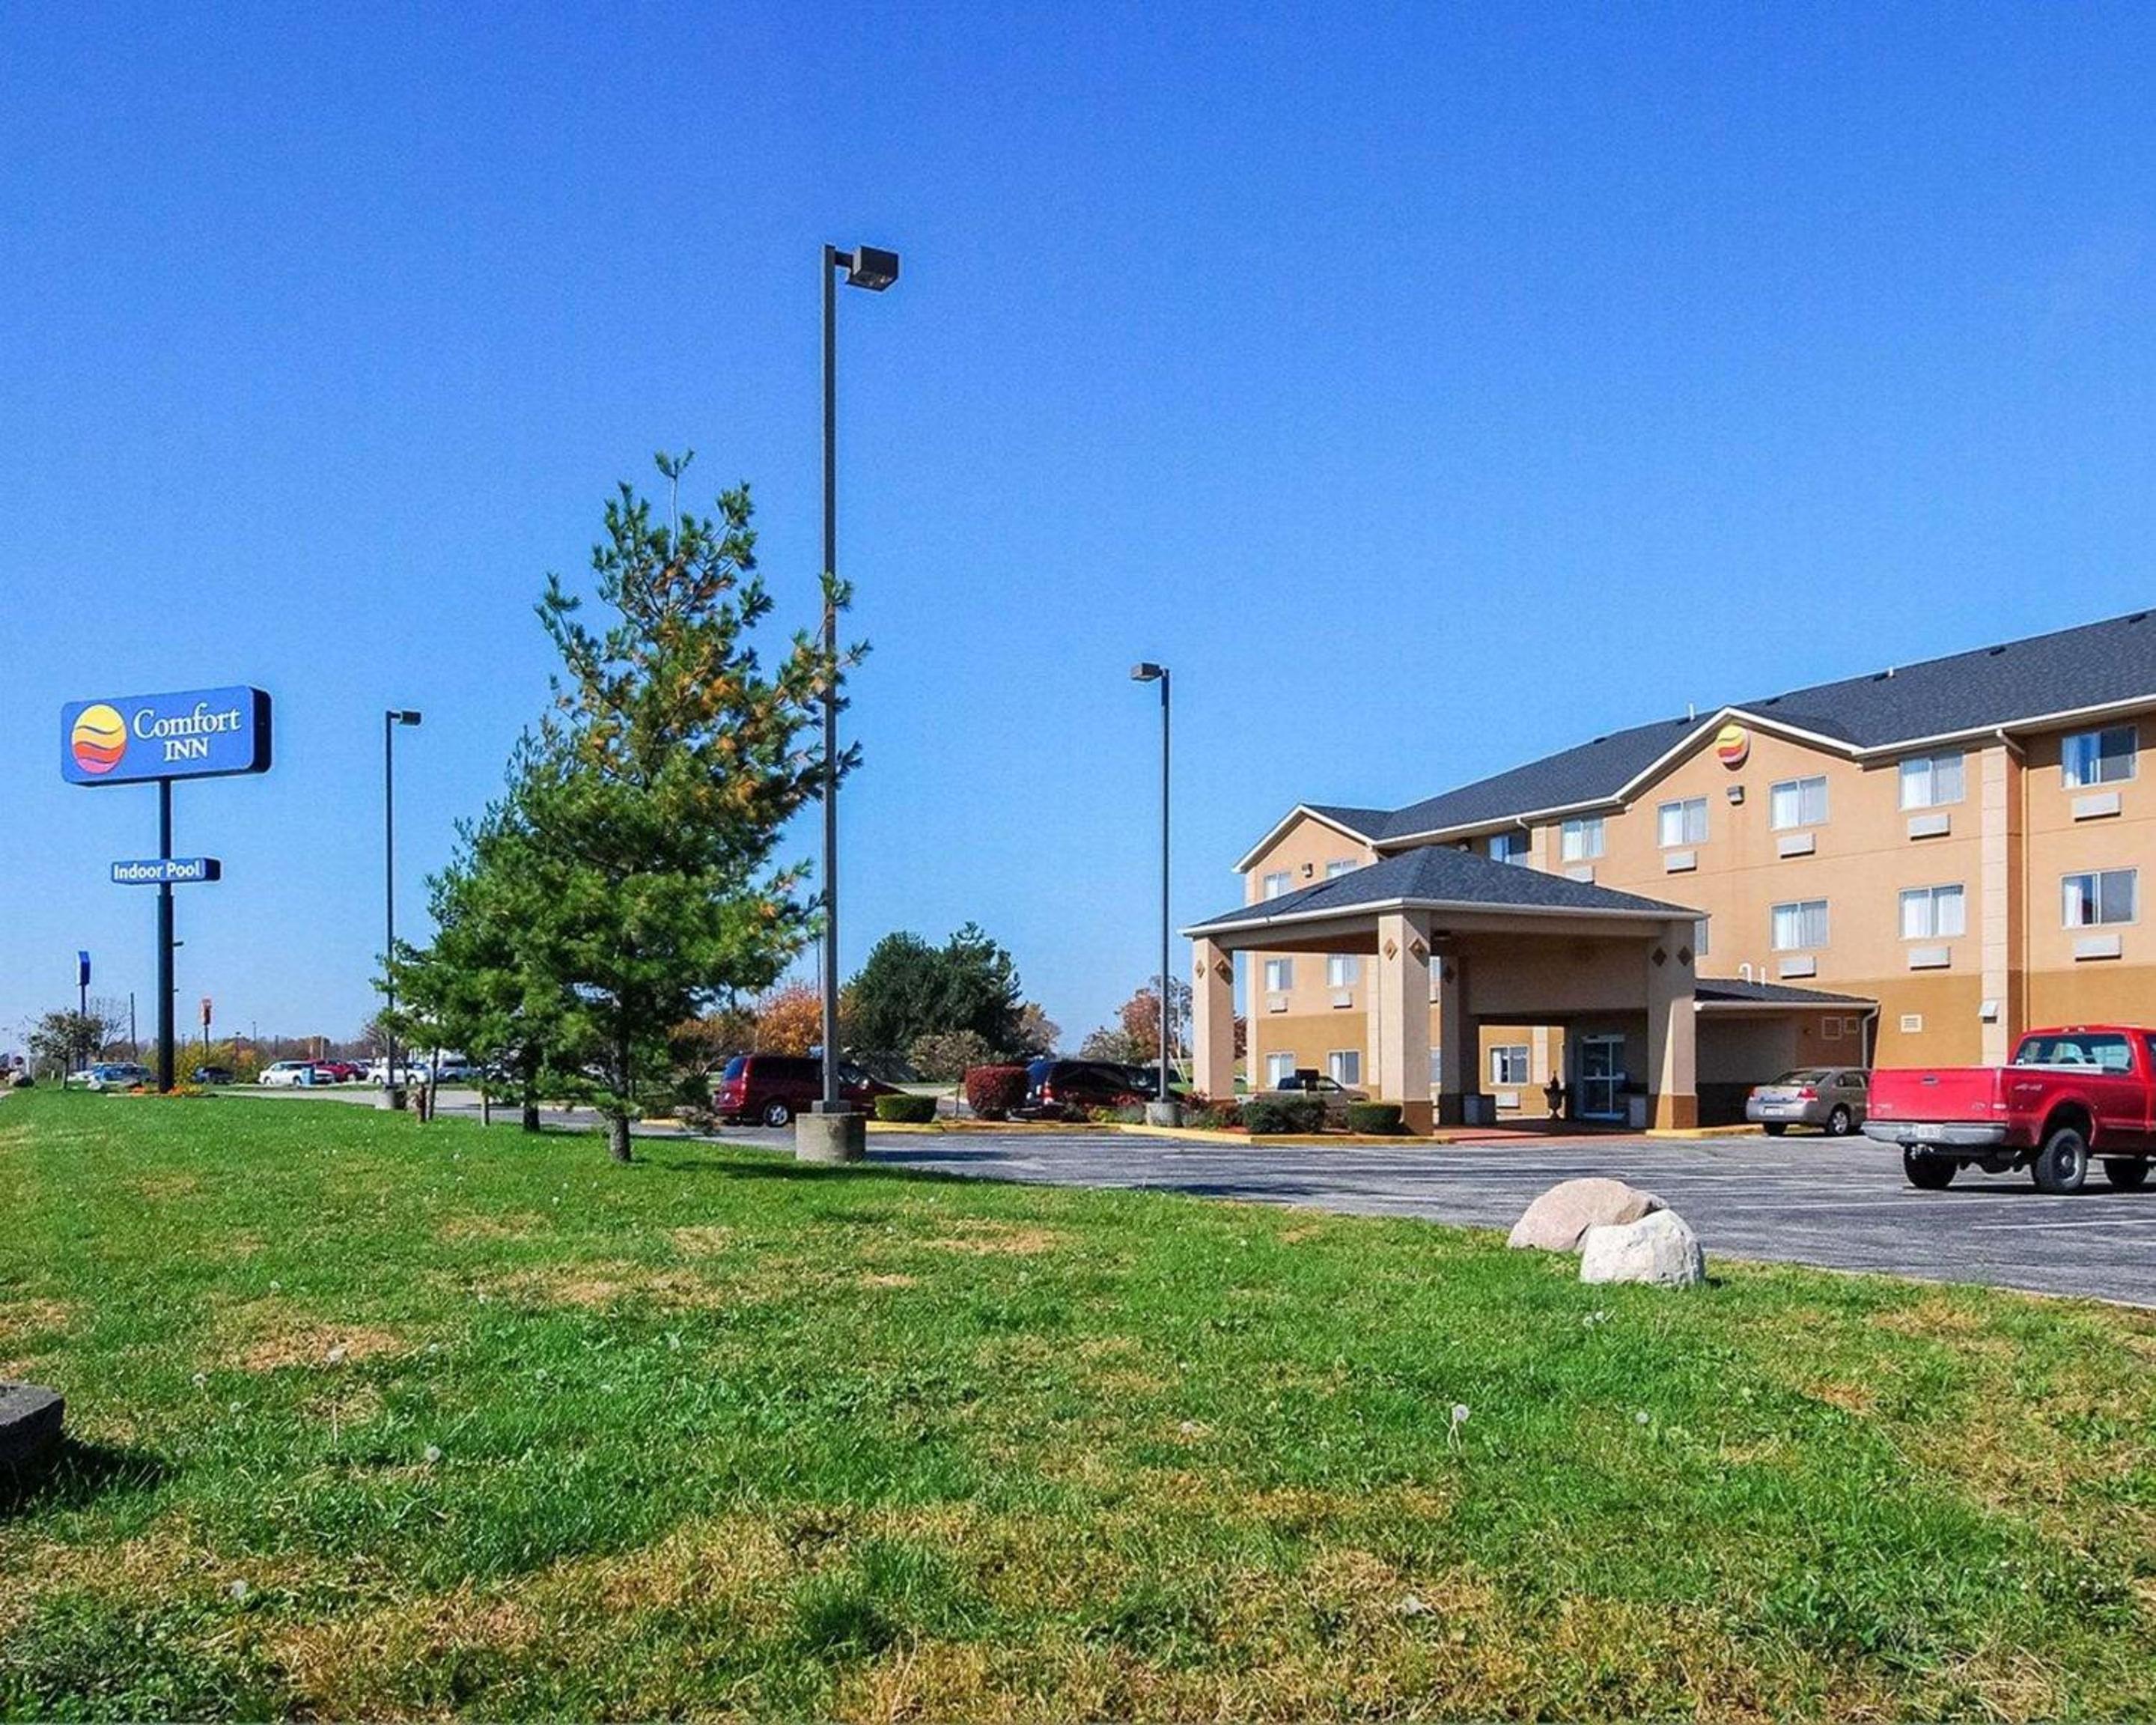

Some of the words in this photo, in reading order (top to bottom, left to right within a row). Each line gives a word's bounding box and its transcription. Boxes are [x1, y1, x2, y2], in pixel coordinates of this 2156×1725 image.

[133, 702, 241, 739] Comfort
[164, 737, 208, 761] INN
[114, 862, 164, 880] Indoor
[166, 860, 201, 877] Pool
